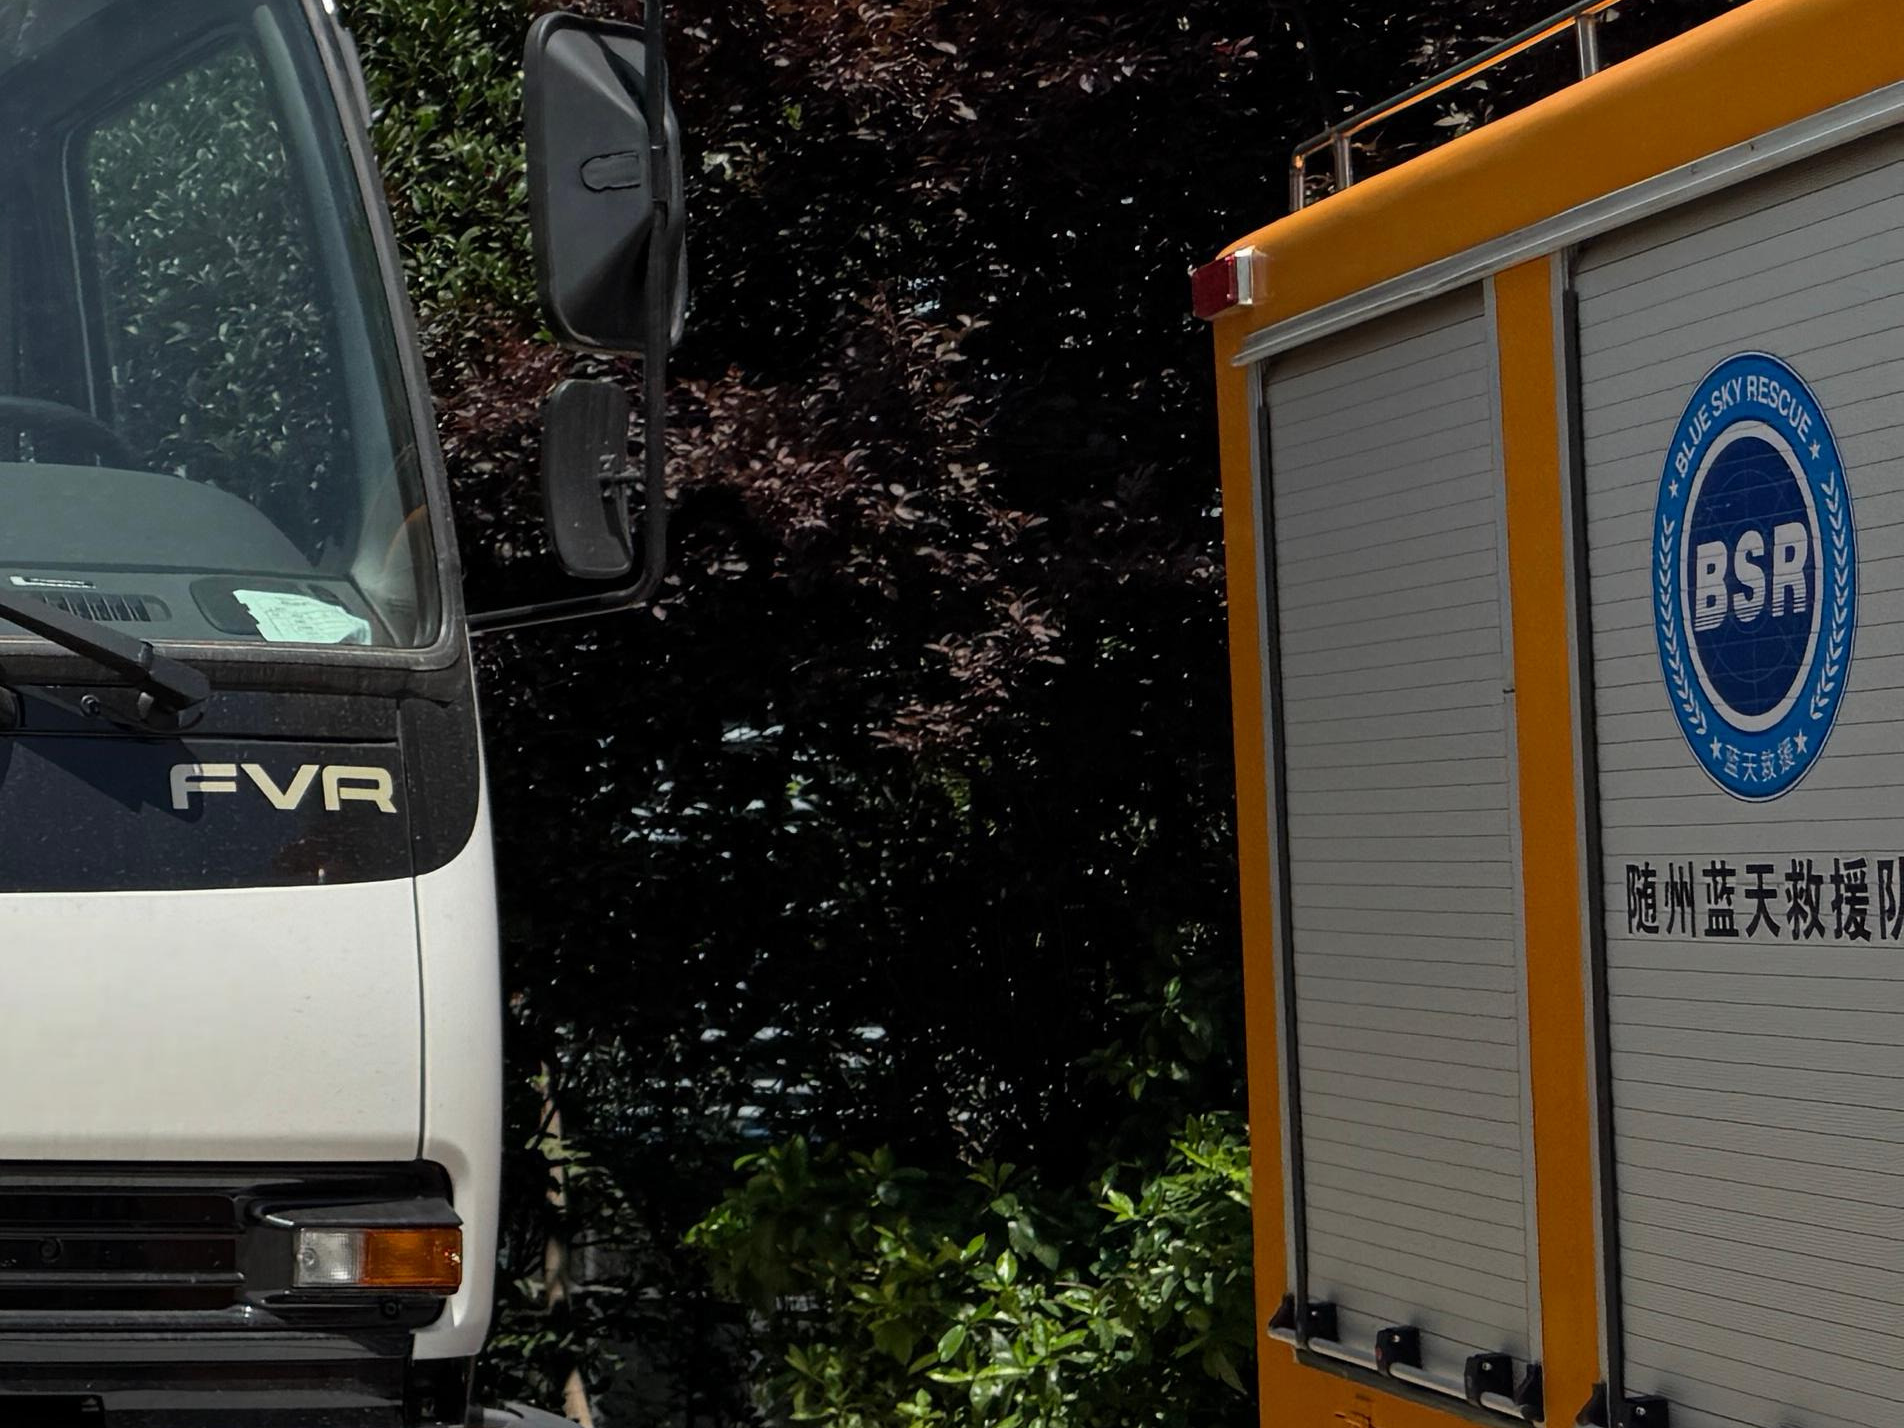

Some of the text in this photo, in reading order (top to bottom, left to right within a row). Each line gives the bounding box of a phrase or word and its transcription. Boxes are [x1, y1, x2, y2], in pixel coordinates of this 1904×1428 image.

[1675, 375, 1812, 478] BLUE SKY RESCUE
[1695, 522, 1808, 632] BSR
[170, 763, 397, 814] FVR
[1724, 737, 1796, 782] 蓝天救援
